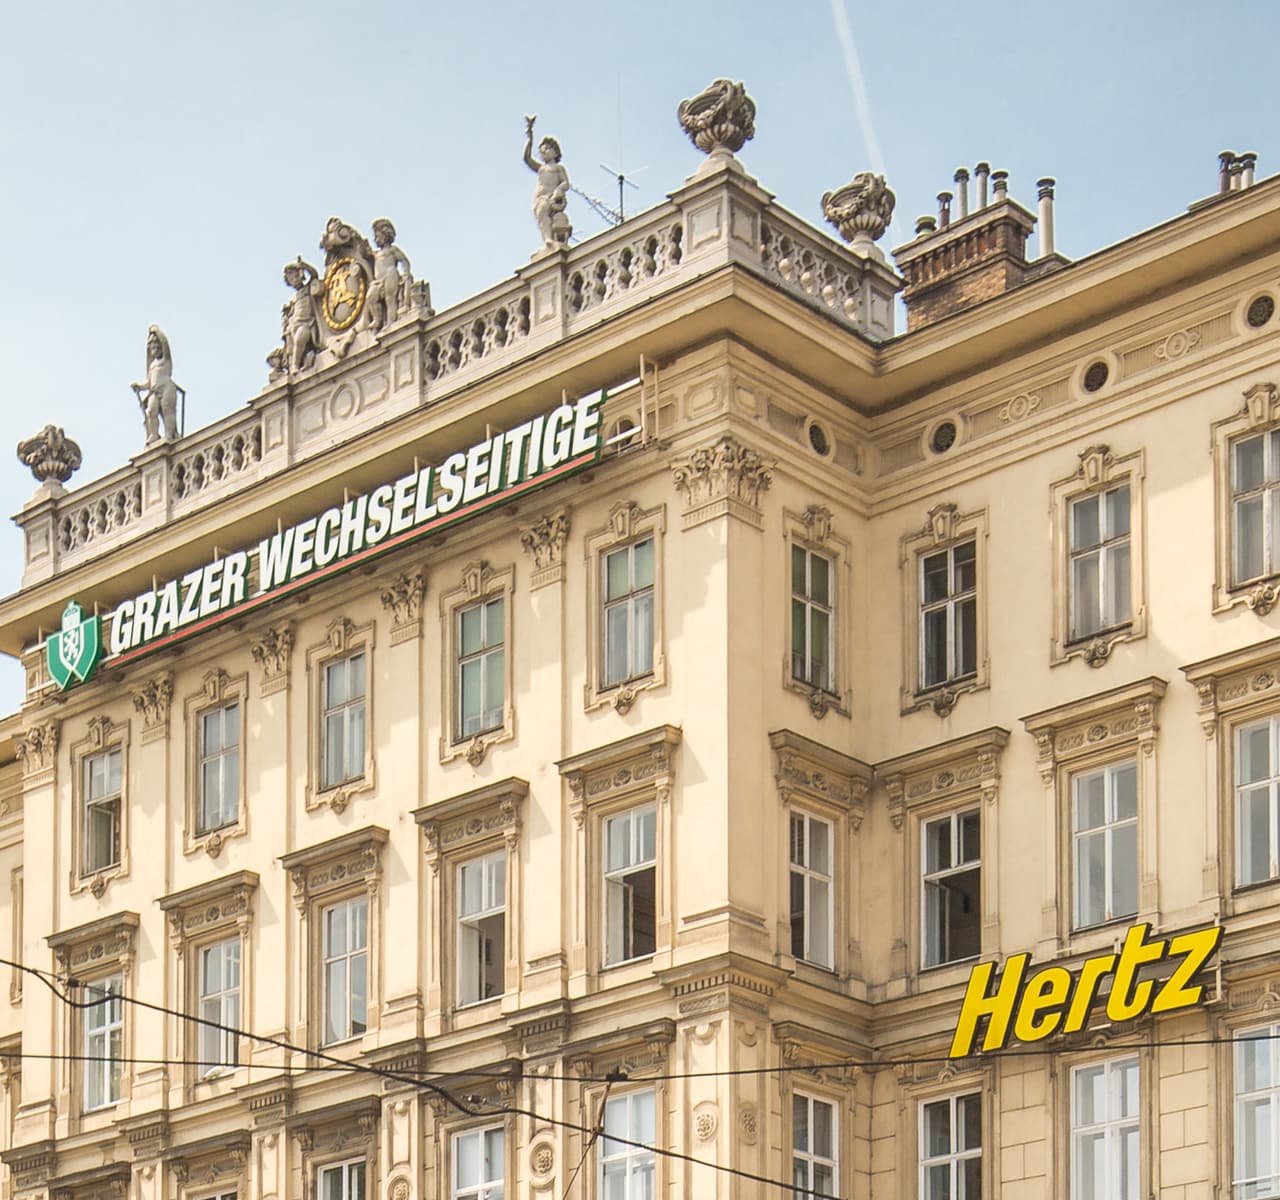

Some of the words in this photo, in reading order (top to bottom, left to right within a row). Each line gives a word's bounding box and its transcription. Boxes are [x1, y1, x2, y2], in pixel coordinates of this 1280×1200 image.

[110, 550, 248, 654] GRAZER
[257, 390, 605, 593] WECHSELSEITIGE
[949, 922, 1224, 1059] Hertz
